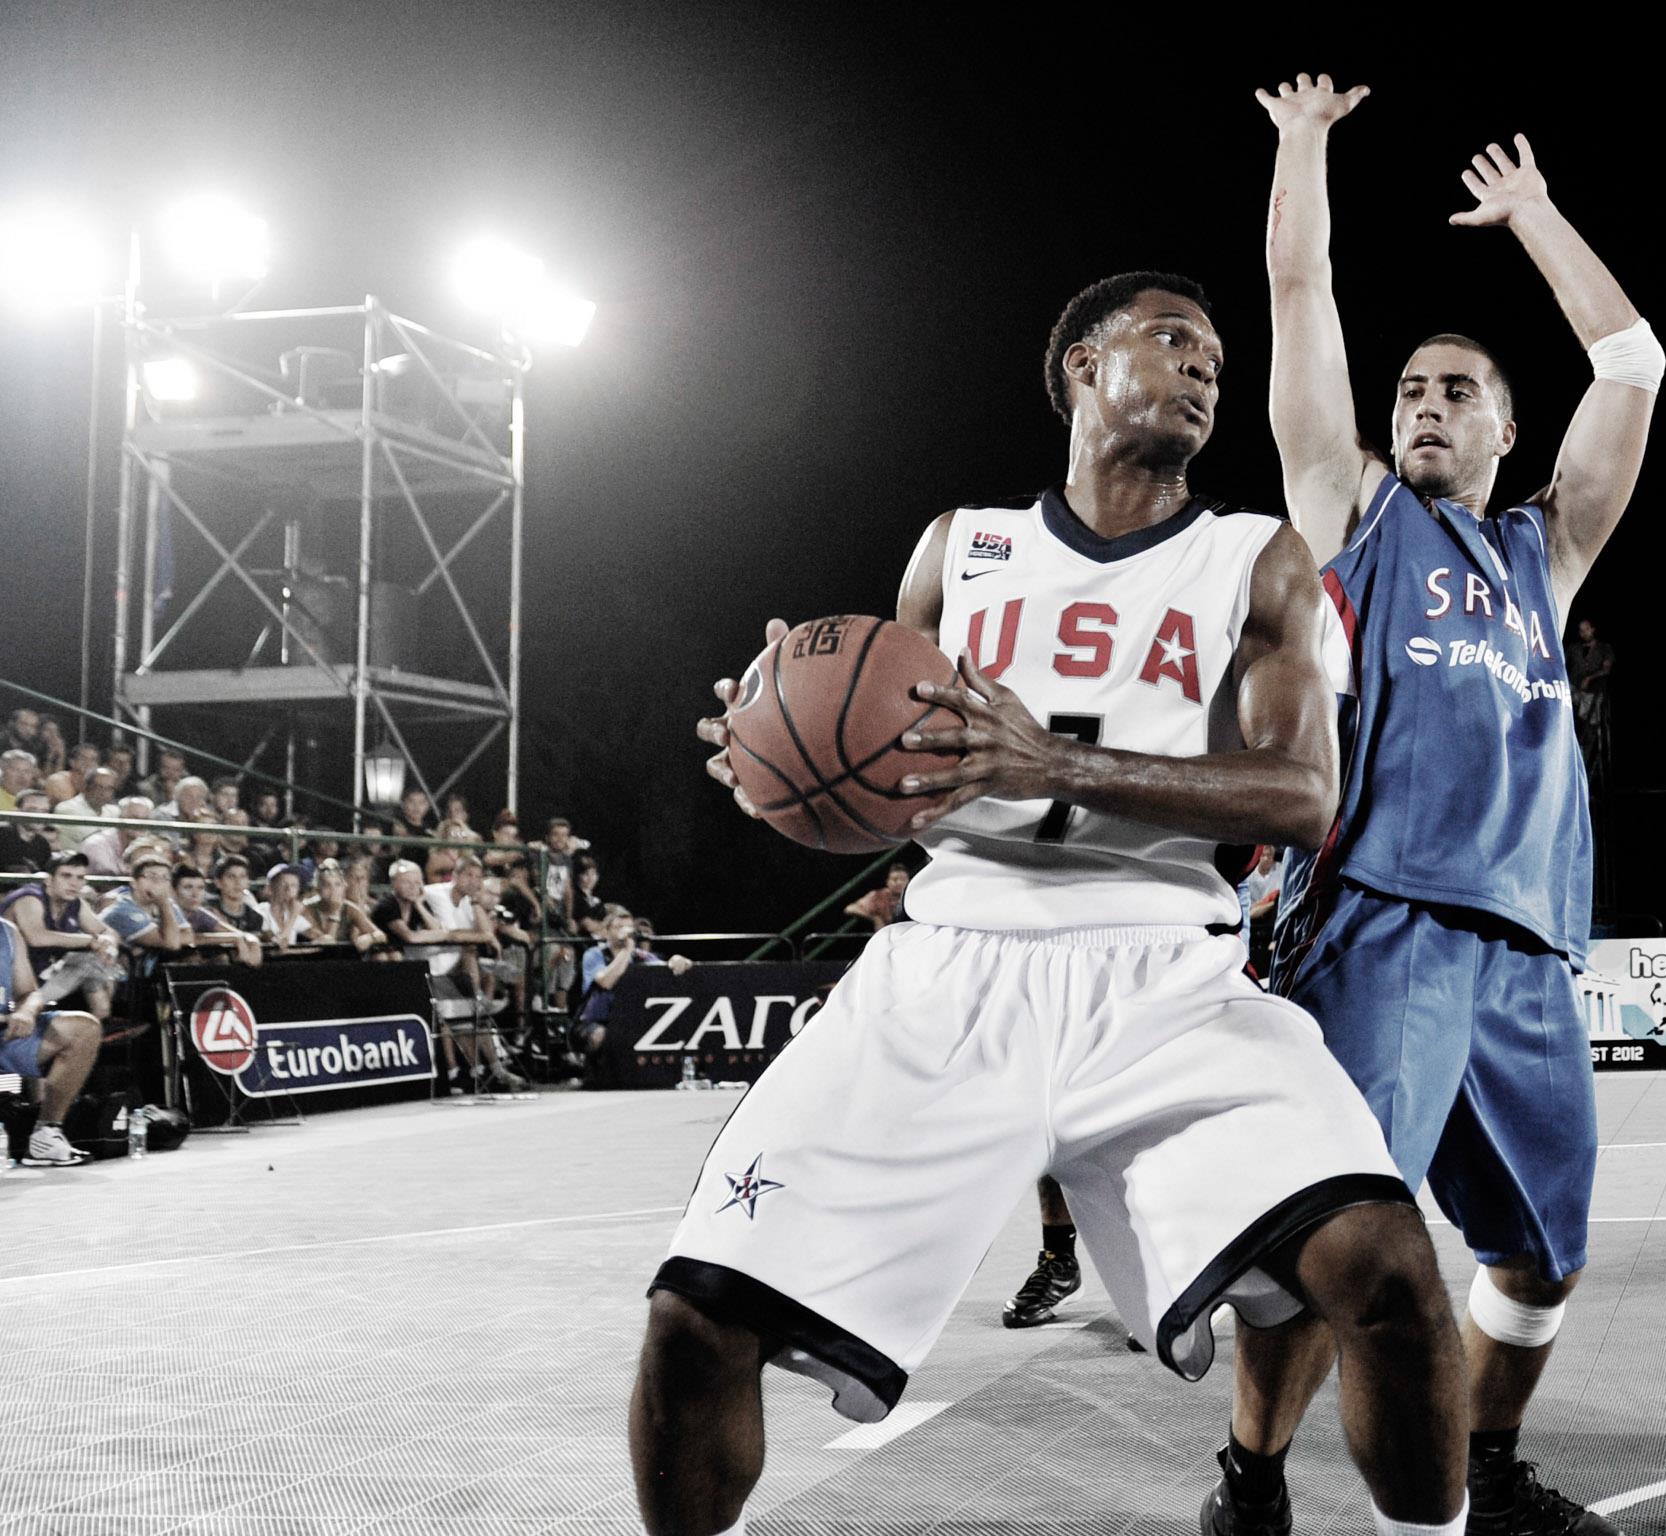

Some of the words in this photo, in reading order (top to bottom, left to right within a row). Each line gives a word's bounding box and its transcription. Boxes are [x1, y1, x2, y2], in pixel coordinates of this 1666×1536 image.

[971, 531, 1012, 552] USA
[965, 596, 1204, 708] USA
[266, 1028, 419, 1080] Eurobank
[1591, 1046, 1609, 1062] ST
[1611, 1045, 1645, 1062] 2012
